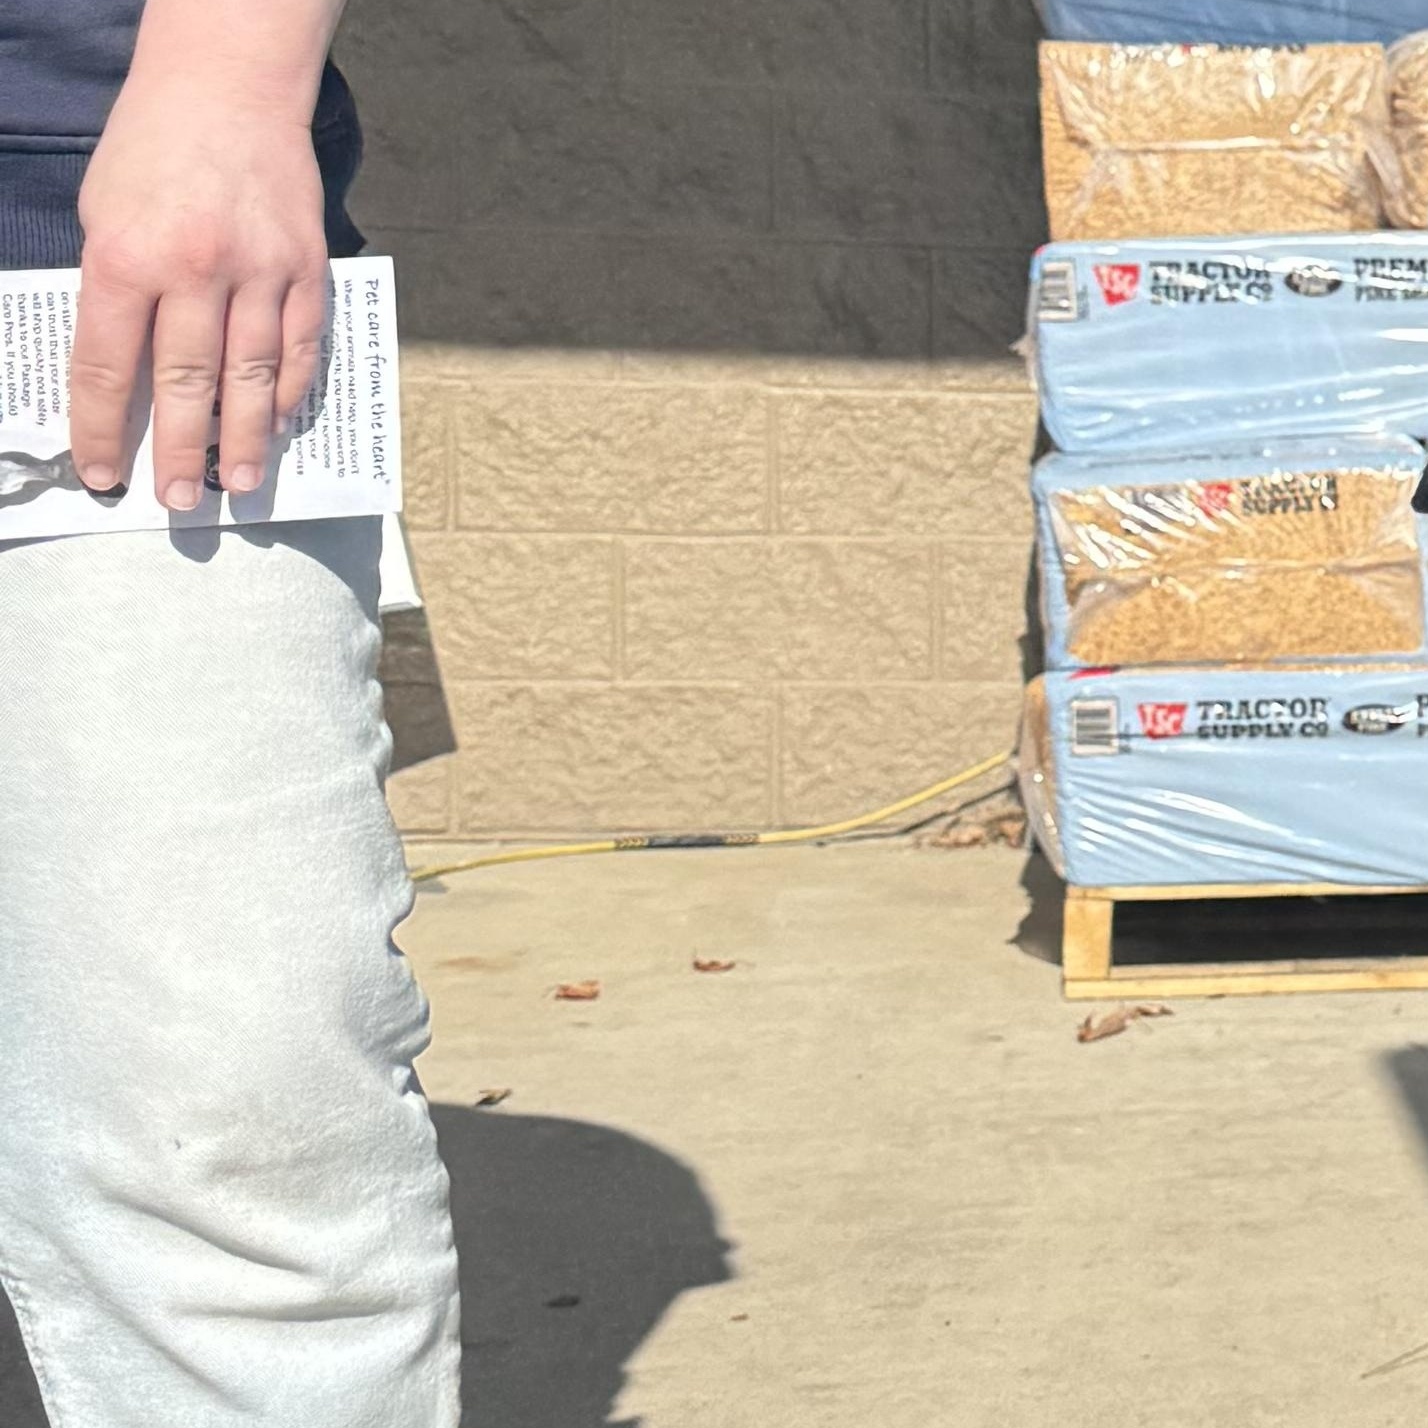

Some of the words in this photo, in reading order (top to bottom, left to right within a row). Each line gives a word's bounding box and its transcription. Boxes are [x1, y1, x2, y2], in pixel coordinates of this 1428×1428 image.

[365, 278, 380, 306] Pet
[367, 312, 380, 348] care
[364, 353, 387, 397] from
[371, 403, 387, 429] the
[1142, 704, 1184, 735] TSC
[1196, 697, 1329, 721] TRACTOR
[1197, 722, 1294, 740] SUPPLY
